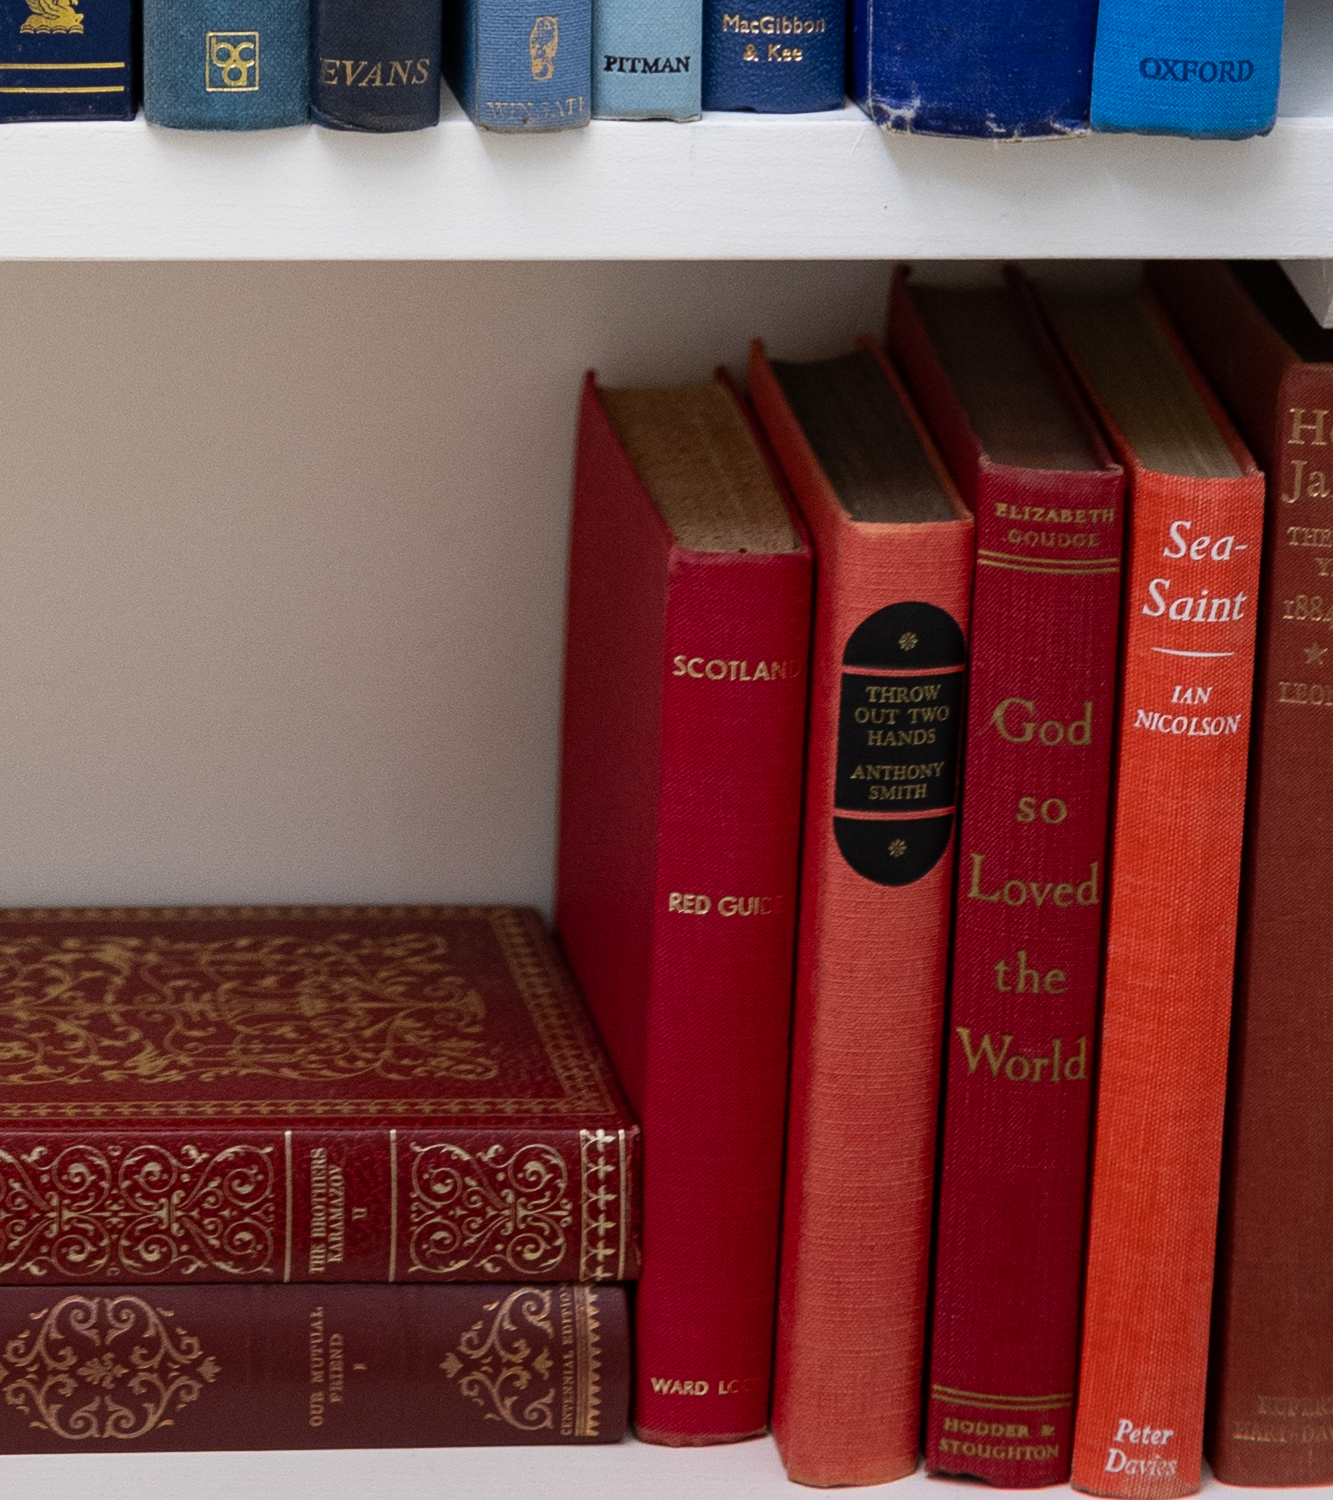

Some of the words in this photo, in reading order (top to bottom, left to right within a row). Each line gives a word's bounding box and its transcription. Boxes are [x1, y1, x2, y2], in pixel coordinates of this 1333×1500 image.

[603, 54, 691, 75] PITMAN
[1139, 57, 1255, 85] OXFORD
[1141, 577, 1247, 623] Saint
[865, 684, 941, 703] THROW
[1170, 684, 1213, 705] IAN
[854, 707, 898, 725] OUT
[908, 705, 950, 723] TWO
[992, 698, 1094, 747] God
[1134, 708, 1241, 737] NICOLSON
[867, 728, 937, 747] HANDS
[850, 761, 945, 780] ANTHONY
[868, 783, 927, 801] SMITH
[967, 852, 1100, 909] Loved
[993, 951, 1068, 995] the
[956, 1025, 1088, 1082] World
[1114, 1420, 1175, 1447] Peter
[1104, 1448, 1178, 1479] Davies
